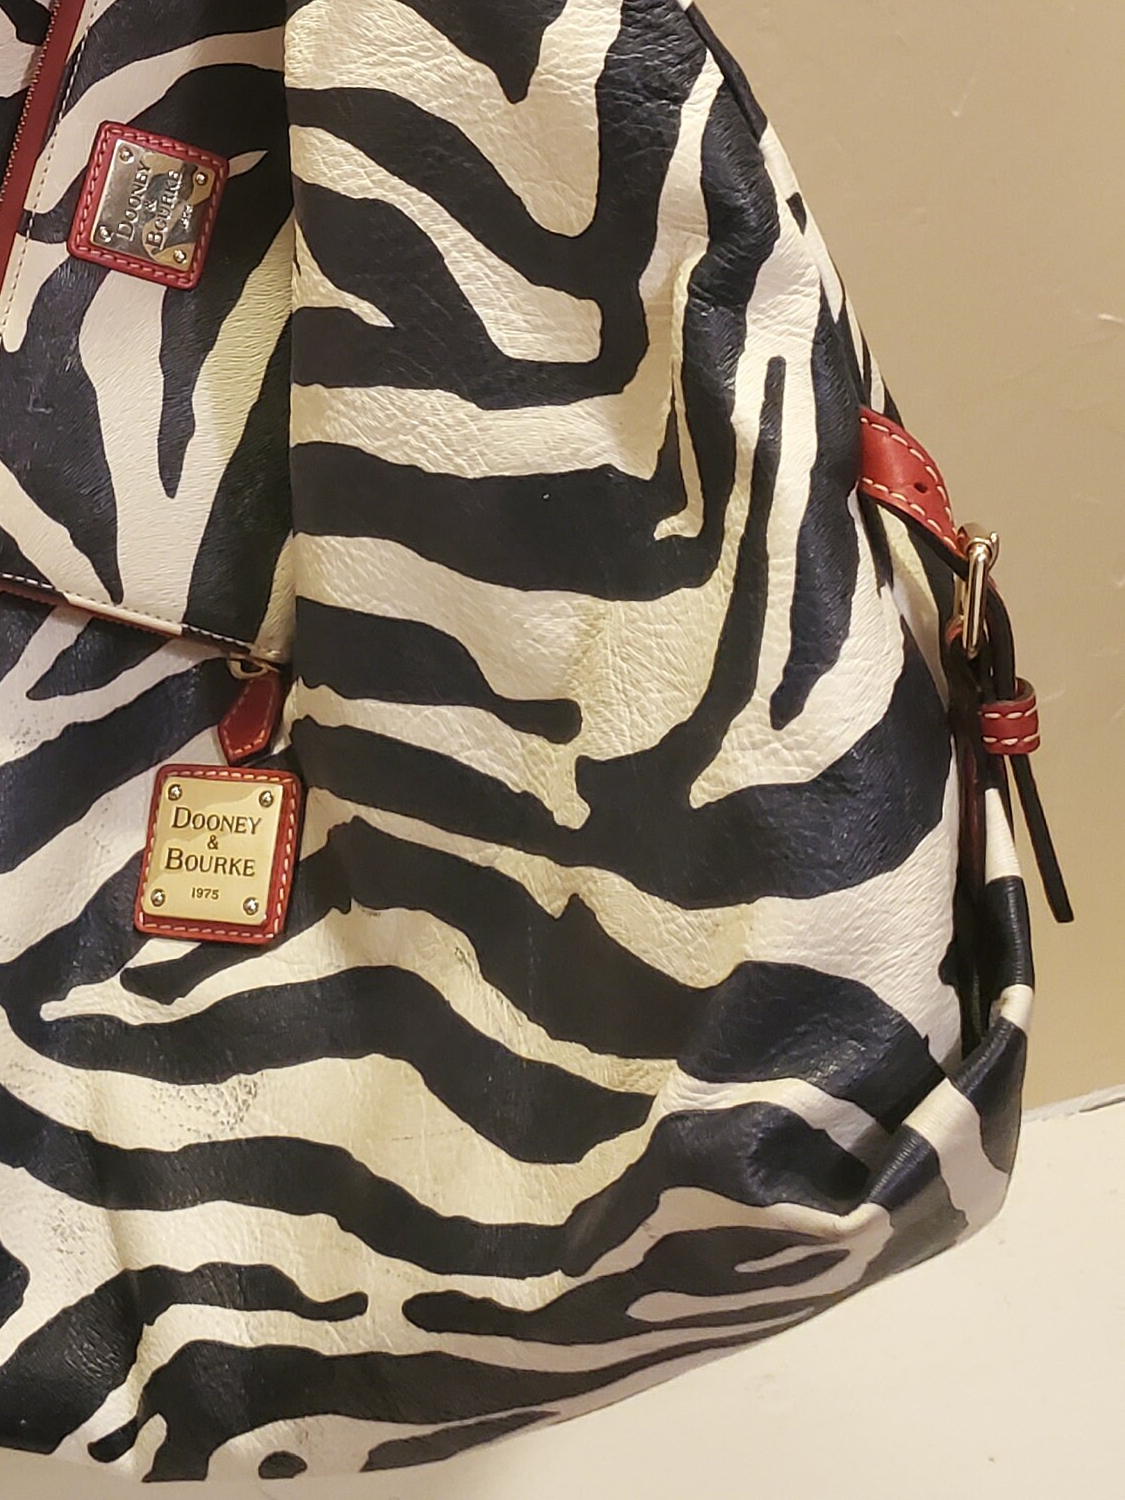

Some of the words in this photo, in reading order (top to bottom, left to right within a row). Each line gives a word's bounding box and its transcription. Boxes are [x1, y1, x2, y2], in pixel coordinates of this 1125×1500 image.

[116, 160, 151, 242] DOONEY
[146, 170, 184, 251] BOURKE
[171, 806, 262, 835] DOONEY
[207, 835, 219, 850] &
[165, 847, 256, 877] BOURKE
[191, 887, 220, 900] 1975
